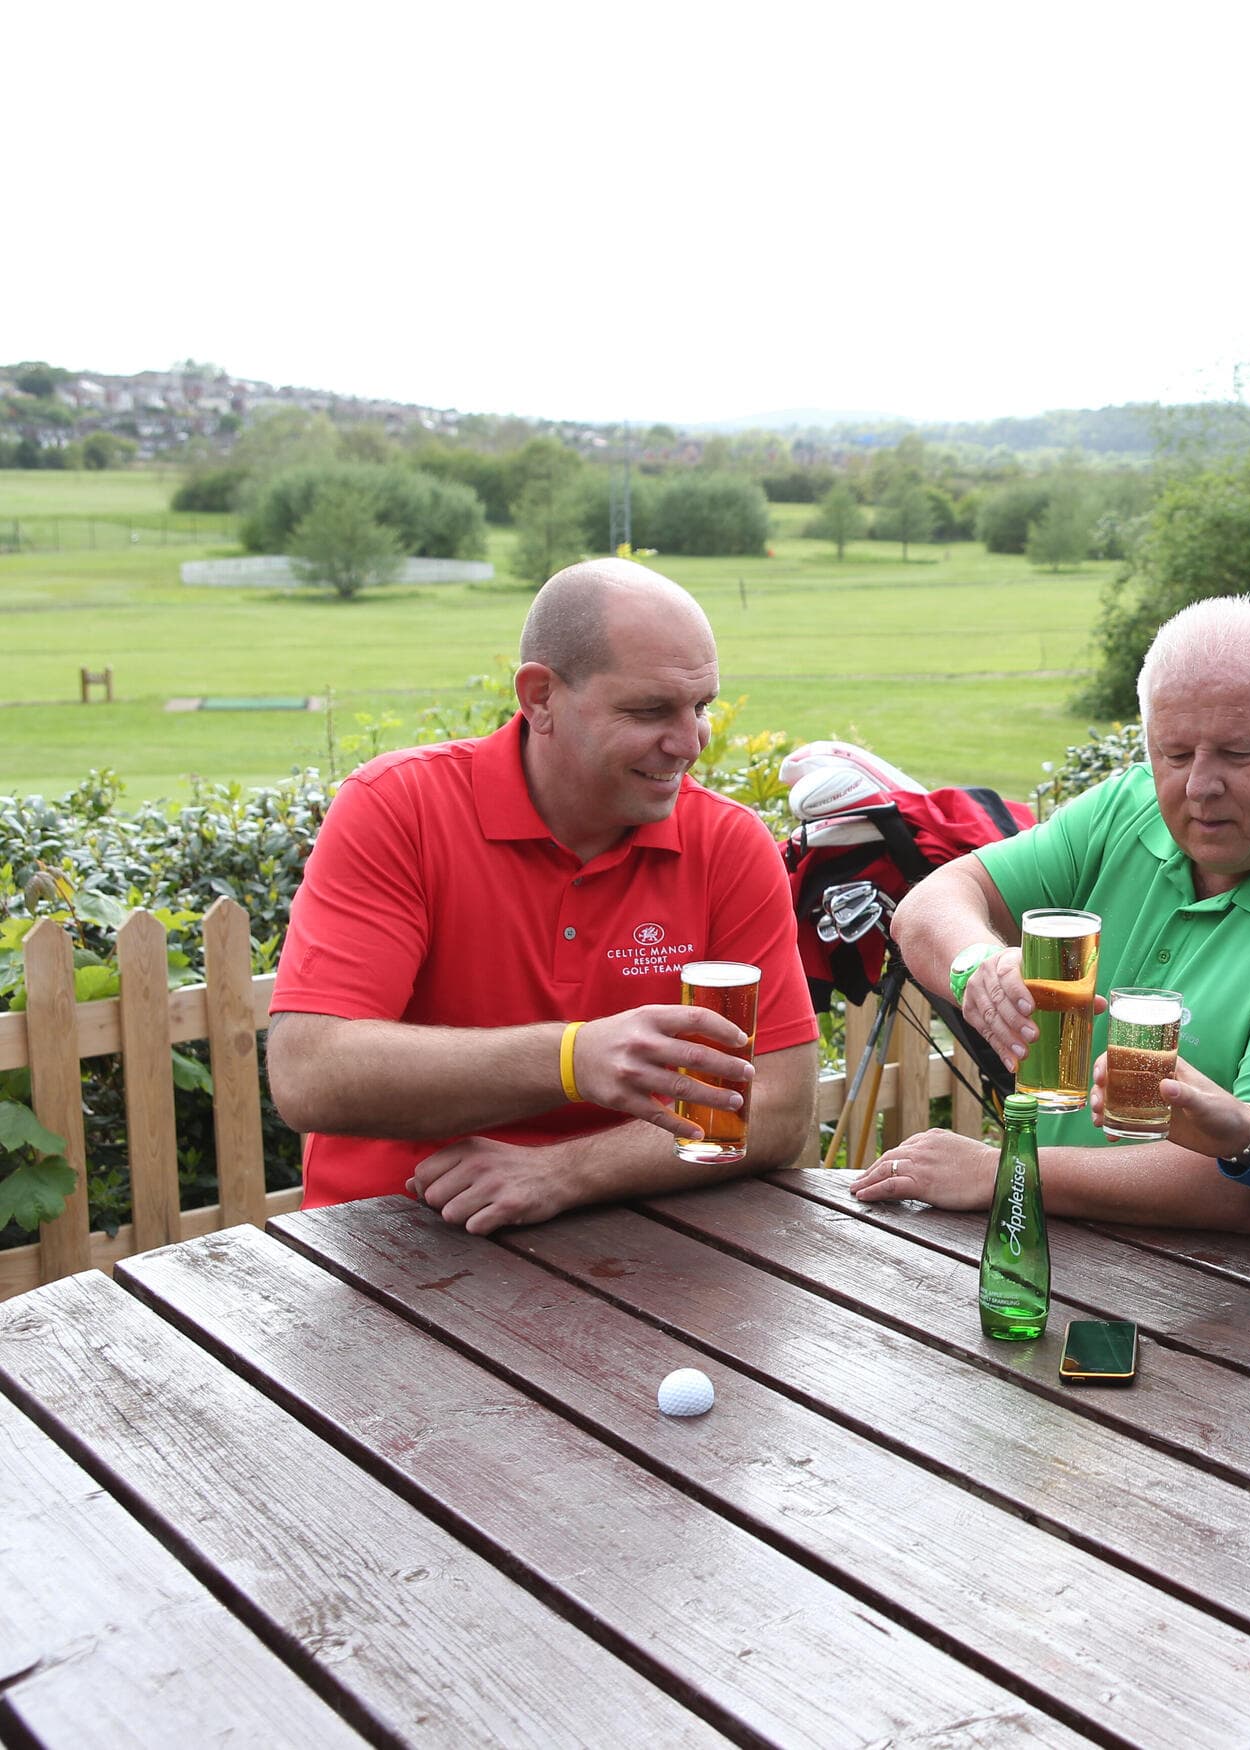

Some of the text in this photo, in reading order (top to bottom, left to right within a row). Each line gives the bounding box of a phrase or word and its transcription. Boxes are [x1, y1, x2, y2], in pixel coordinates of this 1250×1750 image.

[607, 944, 694, 959] CELTIC MANOR
[634, 956, 668, 965] RESORT
[622, 963, 683, 976] GOLF TEAM
[1004, 1158, 1027, 1256] Appletiser
